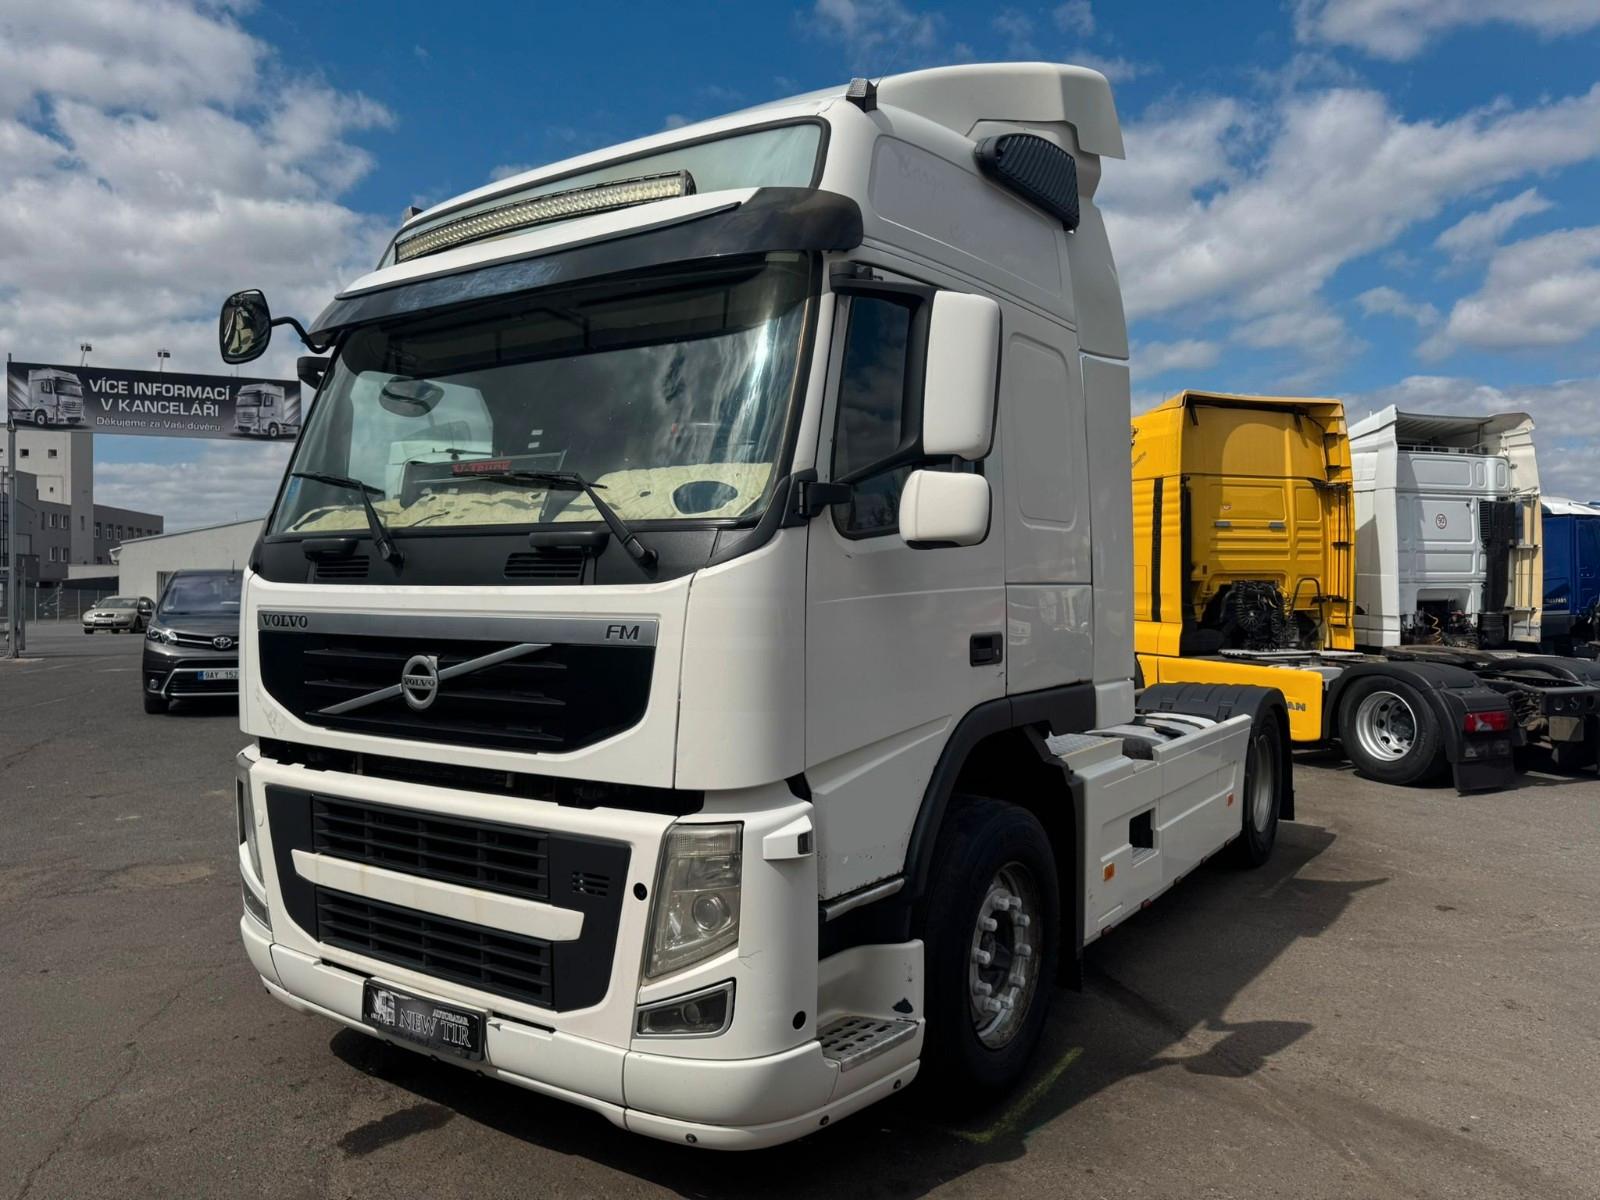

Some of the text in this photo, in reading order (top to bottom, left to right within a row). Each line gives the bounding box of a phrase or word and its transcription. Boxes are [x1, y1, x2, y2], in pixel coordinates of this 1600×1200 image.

[89, 377, 230, 400] VÍCE INFORMACÍ
[101, 398, 219, 417] V KANCELÁŘI
[261, 614, 308, 628] VOLVO
[605, 624, 640, 640] FM
[404, 679, 436, 688] VOLVO
[1286, 701, 1306, 712] AN
[399, 1008, 471, 1048] NEW TIR
